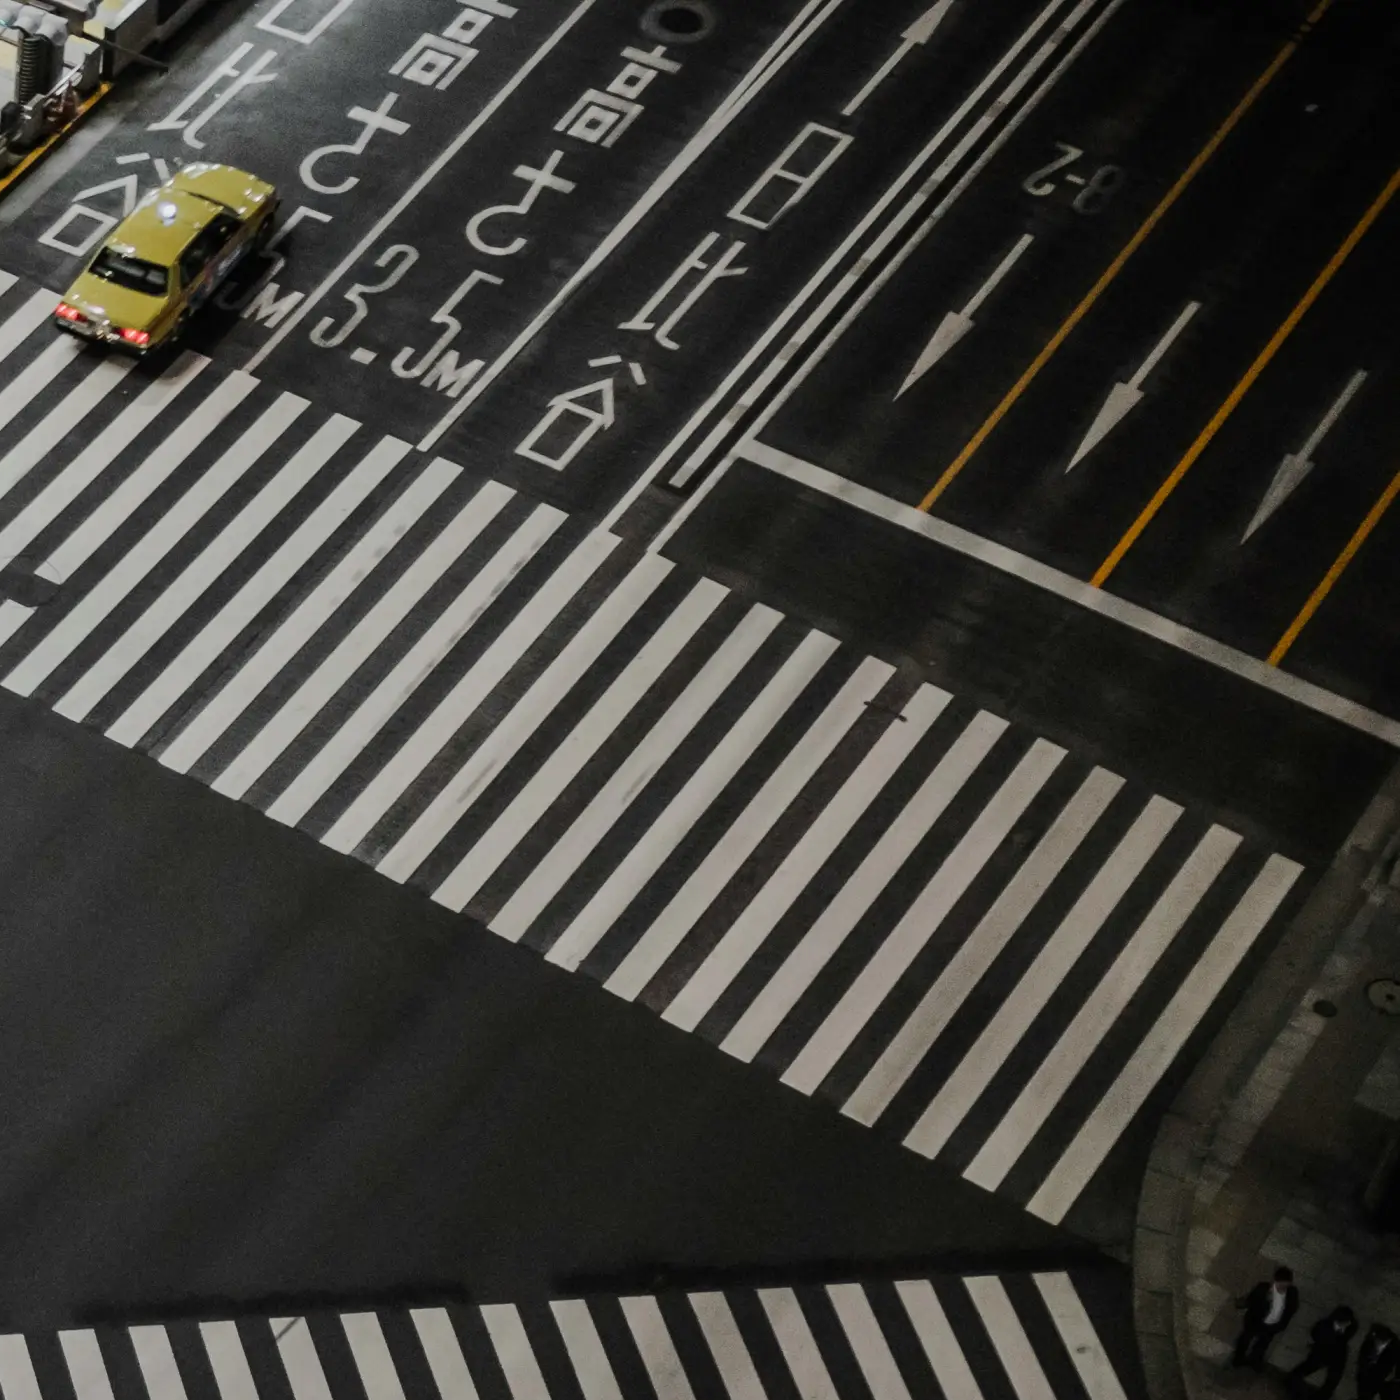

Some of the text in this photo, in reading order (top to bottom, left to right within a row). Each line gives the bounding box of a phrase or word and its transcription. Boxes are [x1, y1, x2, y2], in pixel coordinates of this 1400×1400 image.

[299, 0, 519, 195] 高さ
[465, 45, 683, 256] 高さ
[309, 243, 485, 398] 3.5M
[515, 121, 855, 472] 日比谷
